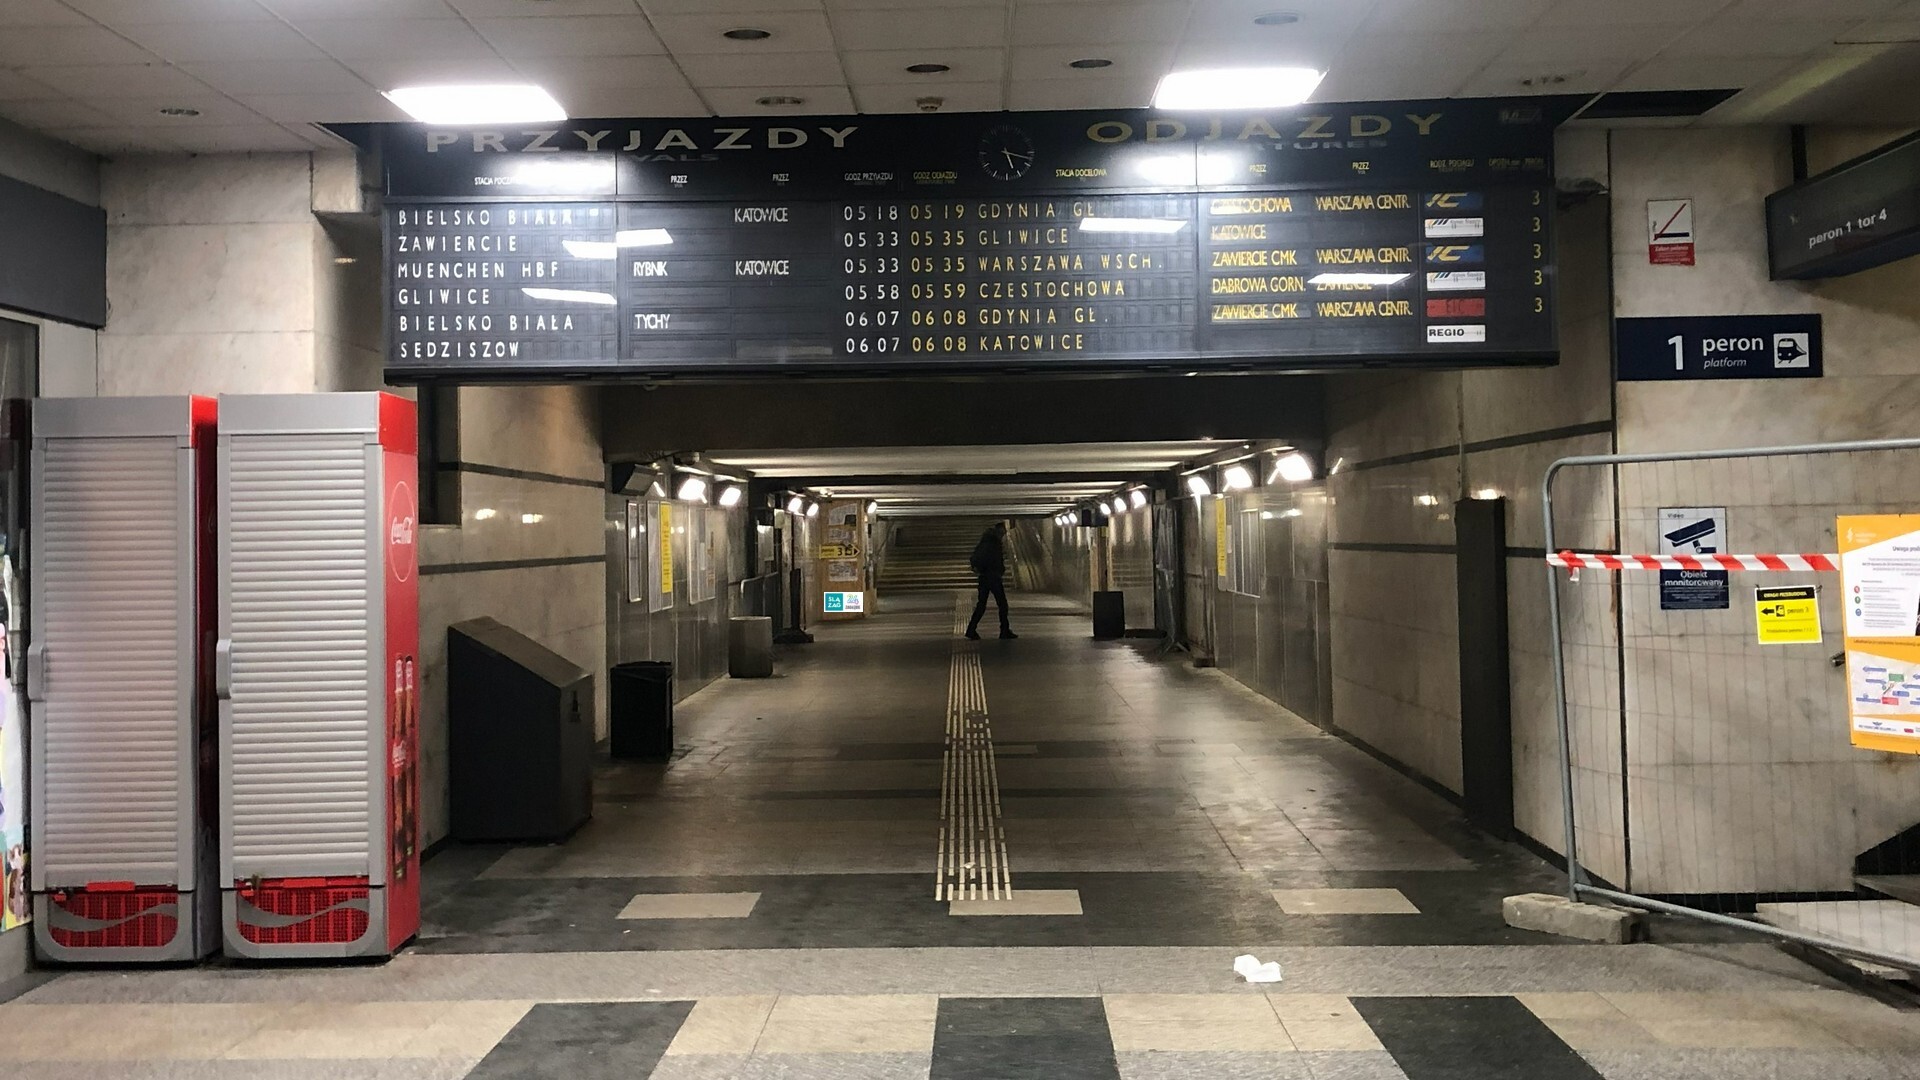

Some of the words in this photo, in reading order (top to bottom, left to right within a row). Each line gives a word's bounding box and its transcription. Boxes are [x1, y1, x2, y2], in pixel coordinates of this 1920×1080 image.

[1087, 114, 1442, 142] ODJAZDY
[427, 127, 858, 152] PRZYJAZDY
[1055, 169, 1074, 177] STACJA
[1075, 168, 1107, 177] DOCELOWA
[1250, 165, 1267, 173] PRZEZ
[1352, 162, 1370, 170] PRZEZ
[671, 175, 688, 183] PRZEZ
[773, 173, 790, 181] PRZEZ
[1316, 195, 1375, 211] WARSZAWA
[1532, 190, 1540, 206] 3
[399, 210, 490, 225] BIELSKO
[734, 208, 789, 223] KATOWICE
[978, 203, 1056, 219] GDYNIA
[1212, 224, 1267, 241] KATOWICE
[1533, 217, 1541, 232] 3
[1809, 227, 1843, 249] peron
[1845, 221, 1852, 233] 1
[1858, 214, 1877, 229] tor
[1879, 207, 1888, 221] 4
[398, 236, 517, 252] ZAWIERCIE
[979, 229, 1068, 246] GLIWICE
[1213, 251, 1268, 267] ZAWIERCIE
[1271, 250, 1298, 266] CMK
[1316, 249, 1376, 264] WARSZAWA
[1533, 243, 1542, 259] 3
[398, 263, 505, 278] MUENCHEN
[522, 261, 559, 277] HBF
[633, 261, 668, 277] RYBNIK
[735, 260, 790, 276] KATOWICE
[979, 255, 1084, 272] WARSZAWA
[1101, 253, 1163, 269] WSCH.
[1213, 278, 1268, 294] DABROWA
[1271, 276, 1307, 293] GORN.
[1534, 270, 1543, 286] 3
[398, 289, 490, 305] GLIWICE
[979, 280, 1125, 299] CZESTOCHOWA
[1213, 304, 1269, 320] ZAWIERCIE
[1272, 303, 1299, 319] CMK
[1317, 302, 1377, 318] WARSZAWA
[1534, 297, 1543, 313] 3
[400, 316, 492, 332] BIELSKO
[509, 315, 574, 331] BIAŁA
[635, 314, 671, 330] TYCHY
[979, 309, 1057, 325] GDYNIA
[1428, 328, 1465, 337] REGIO
[980, 334, 1084, 351] KATOWICE
[1667, 335, 1684, 371] 1
[1702, 337, 1764, 357] peron
[1704, 357, 1747, 370] platform
[1680, 570, 1708, 579] Obiekt
[1665, 579, 1724, 587] monitorowany
